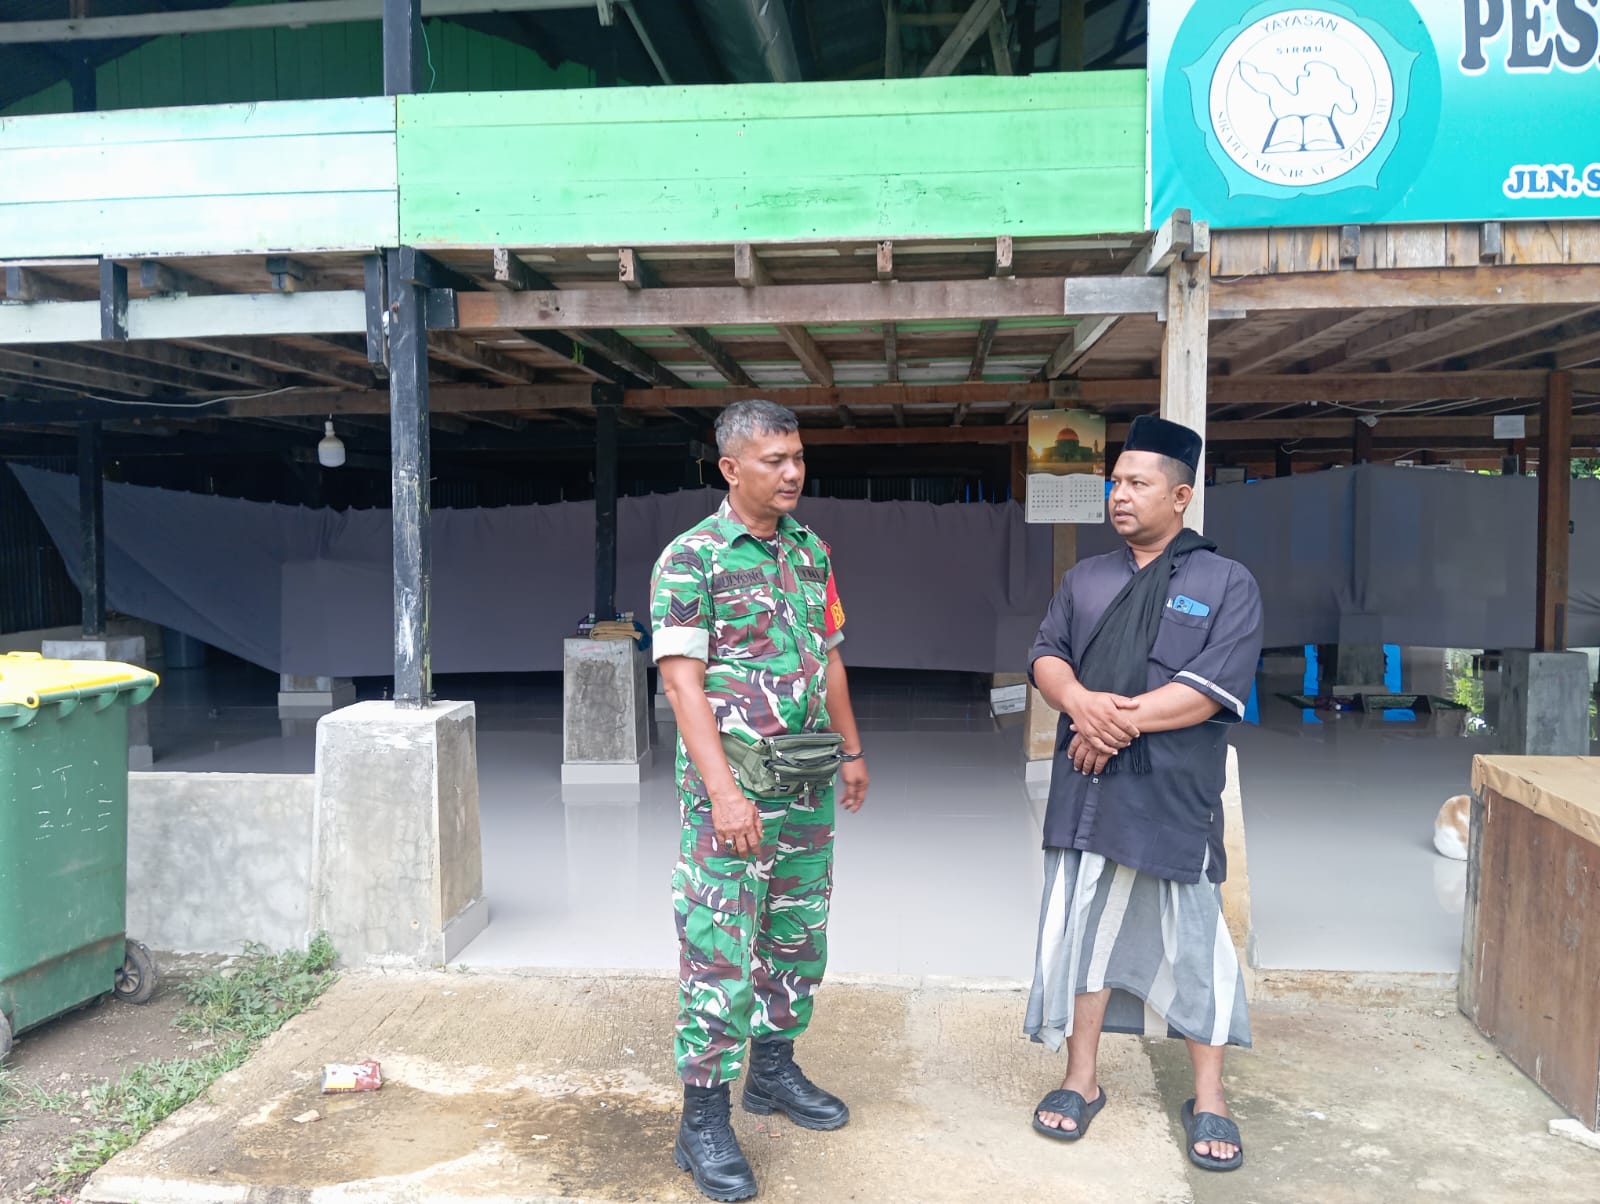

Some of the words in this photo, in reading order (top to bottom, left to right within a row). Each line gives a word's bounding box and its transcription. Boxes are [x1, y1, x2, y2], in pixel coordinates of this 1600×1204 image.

[1261, 14, 1338, 33] YAYASAN
[1461, 0, 1600, 69] PES
[1275, 45, 1322, 55] SIRMU
[1507, 169, 1578, 193] JLN.
